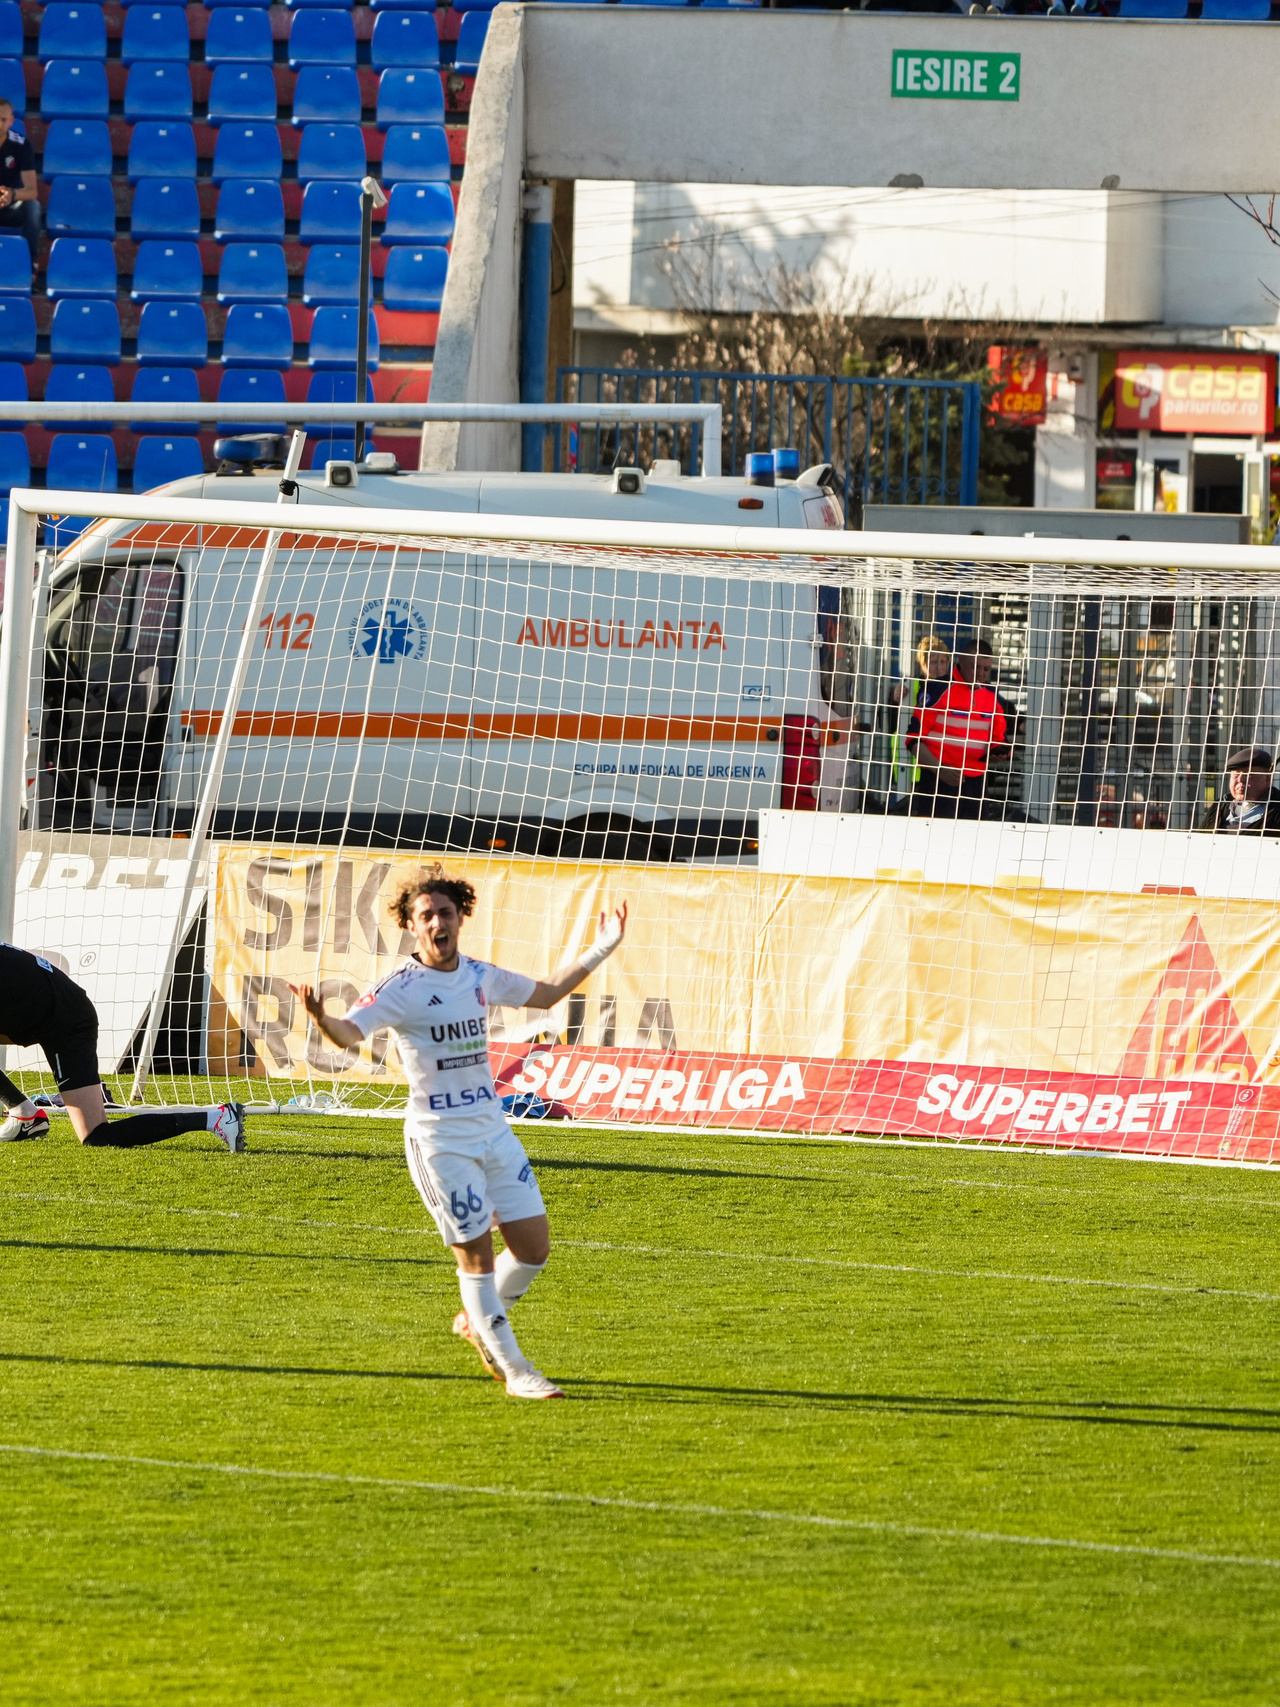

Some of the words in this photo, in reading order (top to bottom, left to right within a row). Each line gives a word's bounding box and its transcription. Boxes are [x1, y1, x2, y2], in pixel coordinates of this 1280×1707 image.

[896, 57, 988, 93] IESIRE
[999, 61, 1017, 93] 2
[1168, 364, 1262, 400] casa
[1003, 392, 1043, 412] casa
[1164, 398, 1259, 417] pariurilor.ro
[260, 612, 316, 650] 112
[516, 618, 728, 651] AMBULANTA
[629, 764, 683, 777] MEDICAL
[687, 765, 704, 777] DE
[708, 766, 766, 779] URGENTA
[243, 855, 435, 957] SIK
[431, 1017, 486, 1043] UNIBE
[429, 1086, 497, 1110] ELSA
[513, 1049, 806, 1112] SUPERLIGA
[916, 1073, 1193, 1135] SUPERBET
[451, 1184, 483, 1220] 66
